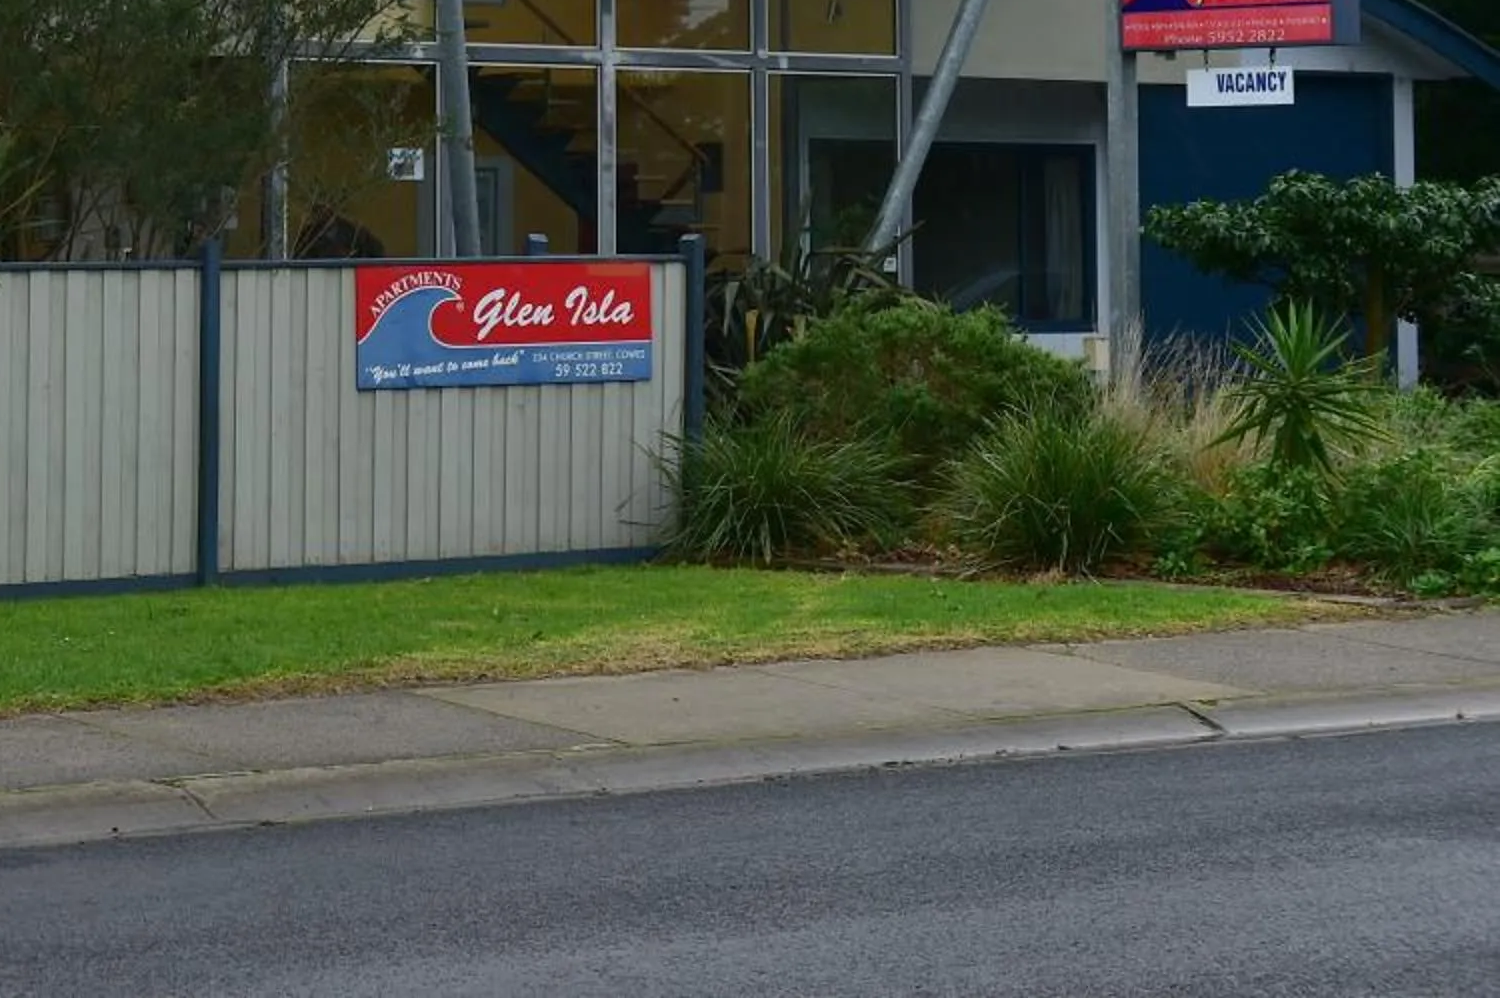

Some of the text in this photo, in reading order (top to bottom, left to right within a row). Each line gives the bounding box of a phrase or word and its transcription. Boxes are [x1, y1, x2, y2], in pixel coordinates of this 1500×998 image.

[1208, 31, 1245, 44] 5952
[1249, 29, 1285, 43] 2822
[1217, 71, 1287, 94] VACANCY
[370, 271, 462, 317] APARTMENTS
[473, 285, 635, 341] Glen Isla
[413, 362, 444, 375] want
[446, 361, 459, 373] to
[461, 358, 489, 370] come
[555, 363, 571, 377] 59
[575, 362, 597, 377] 522
